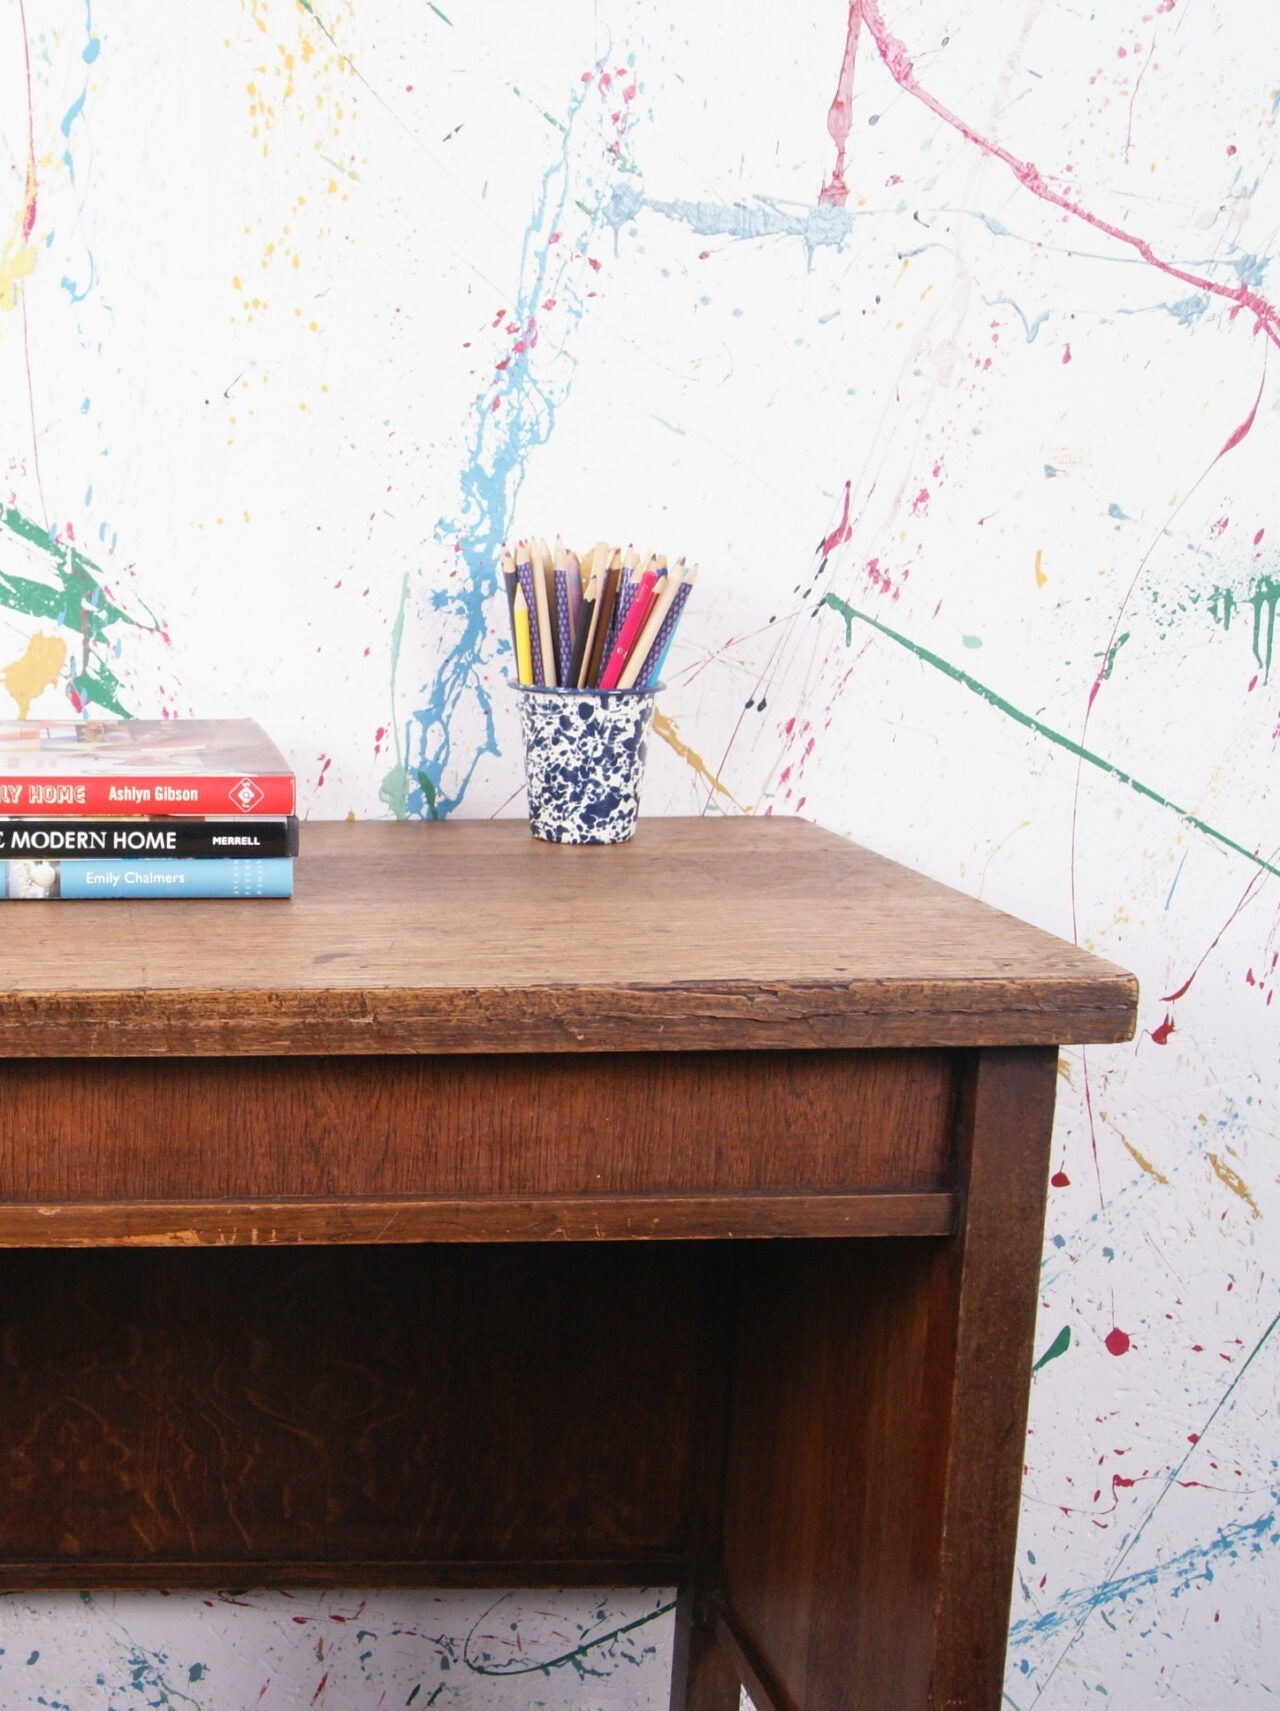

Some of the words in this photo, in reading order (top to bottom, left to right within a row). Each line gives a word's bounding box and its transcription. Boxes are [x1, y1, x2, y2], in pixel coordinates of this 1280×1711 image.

[29, 784, 86, 804] HOME
[108, 786, 151, 804] Ashlyn
[154, 786, 198, 802] Gibson
[10, 831, 107, 849] MODERN
[113, 831, 177, 849] HOME
[212, 836, 261, 846] MERRELL
[85, 871, 120, 887] Emily
[124, 871, 185, 884] Chalmers
